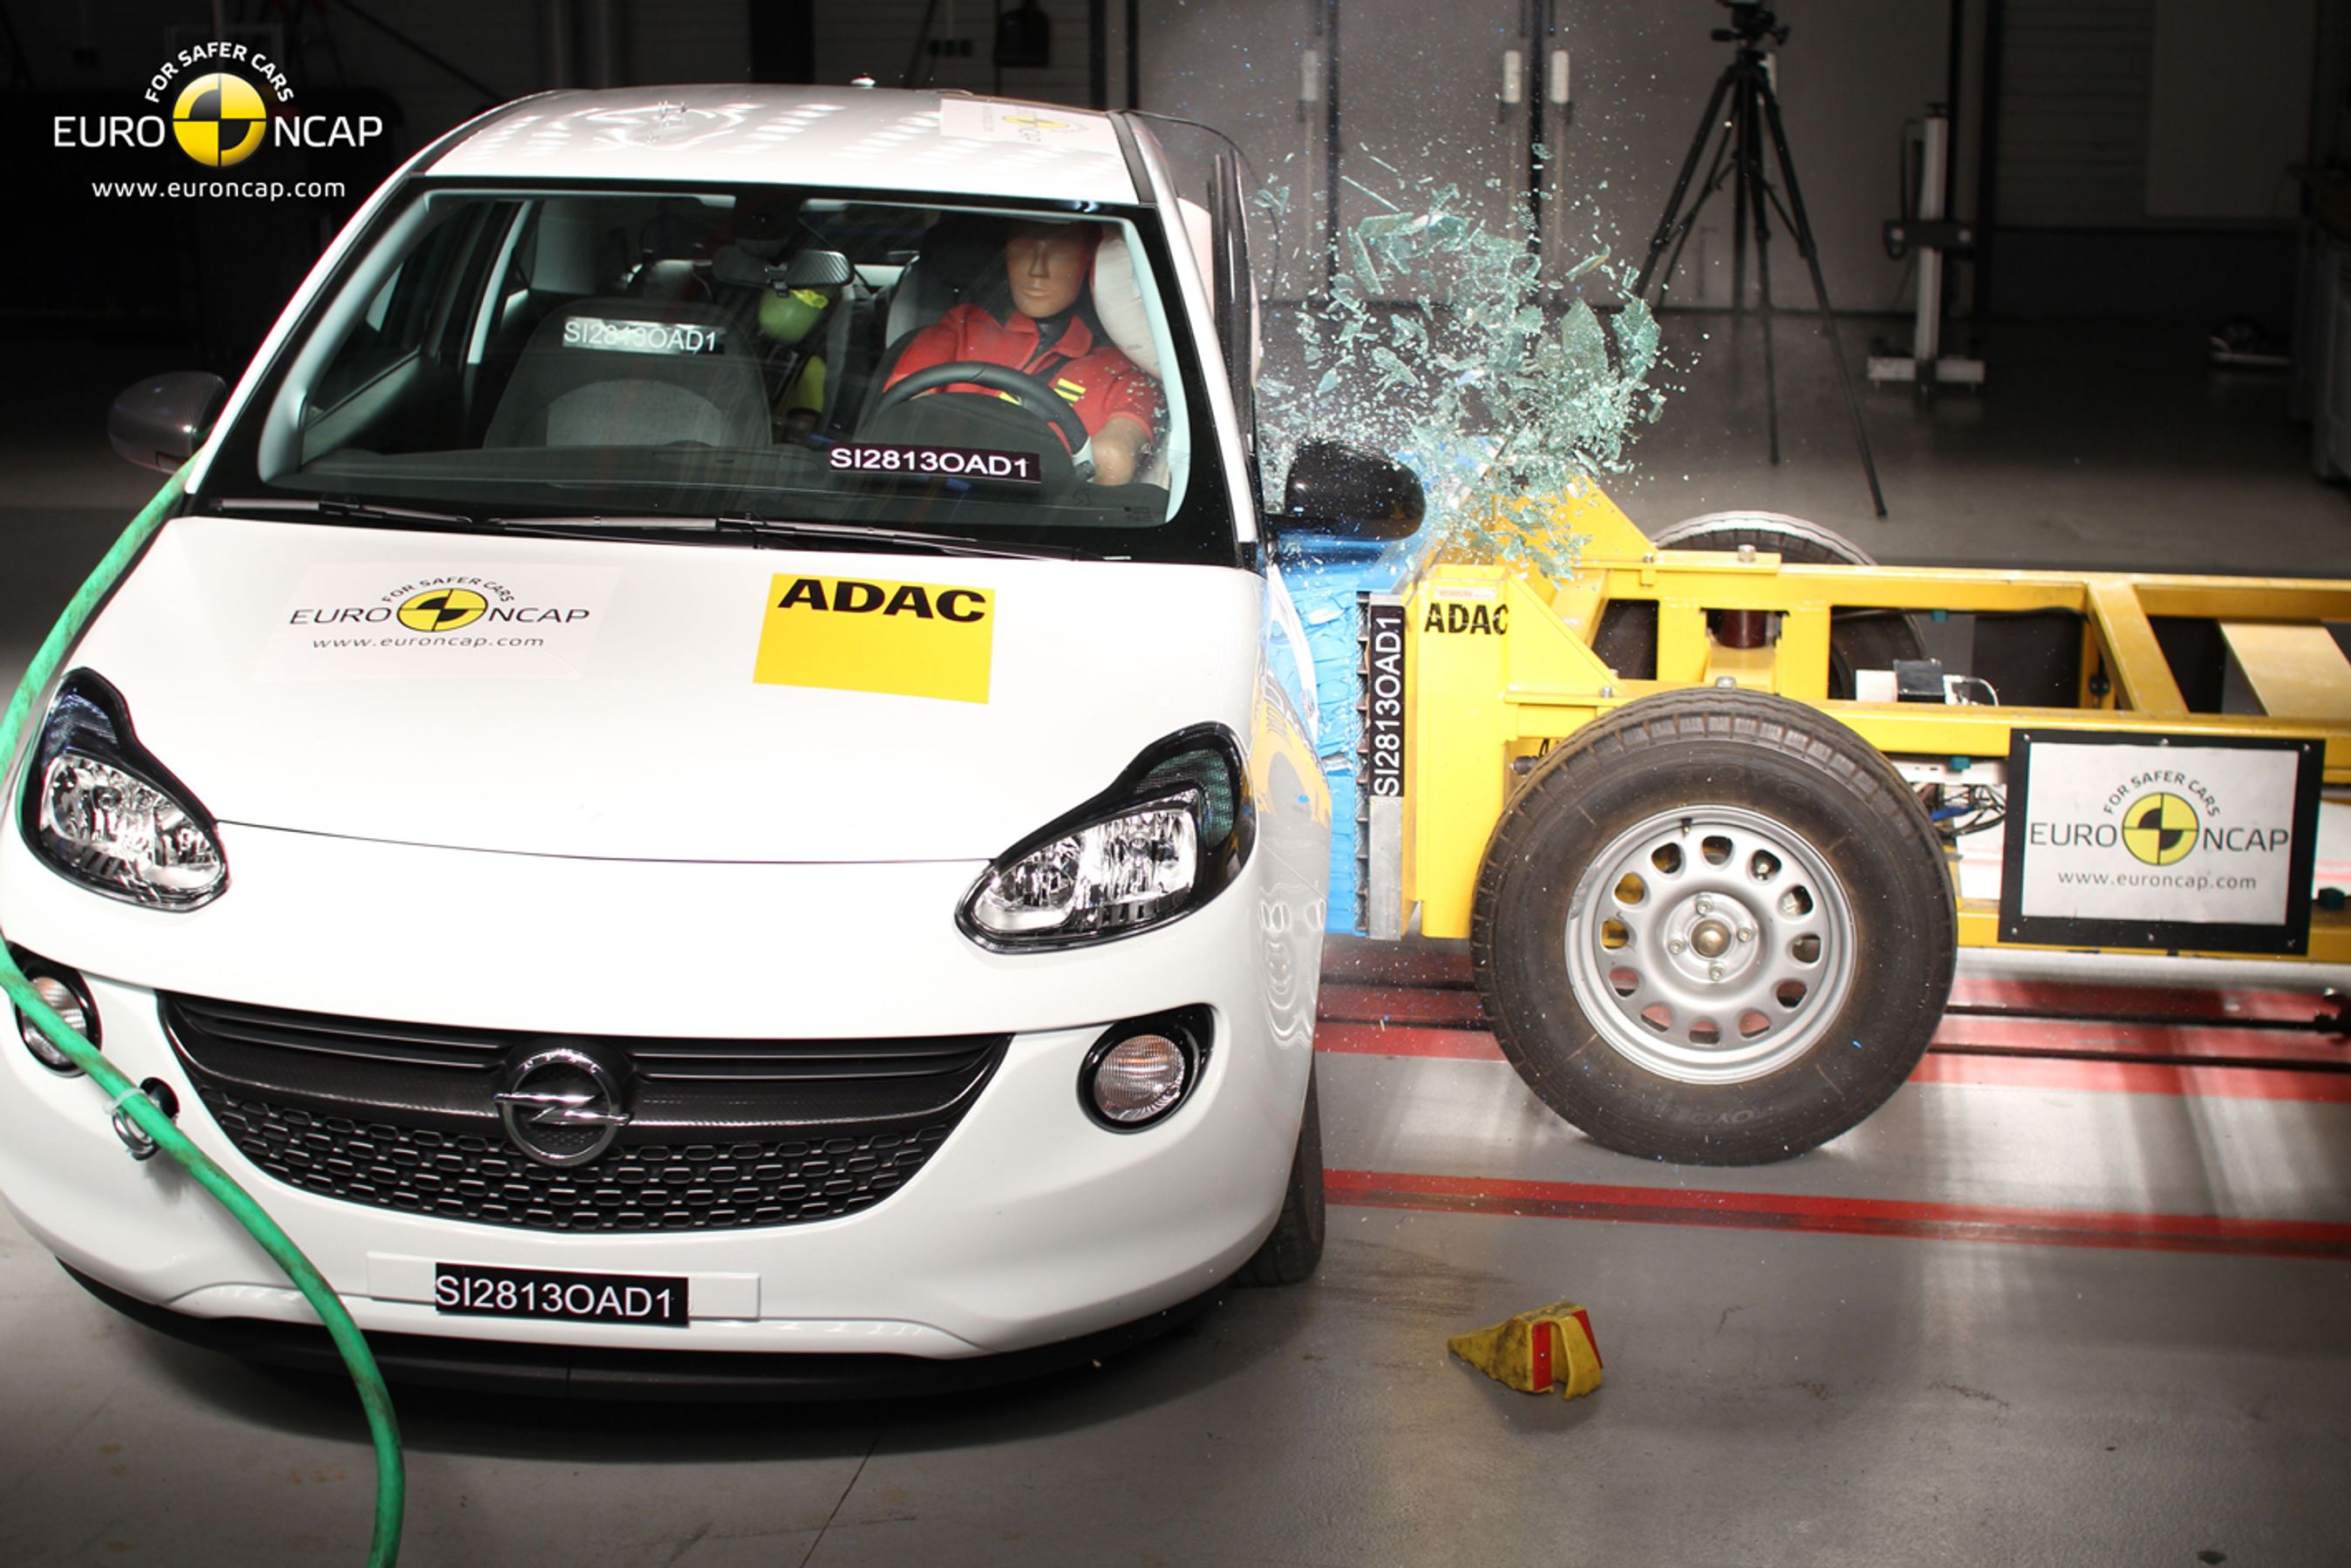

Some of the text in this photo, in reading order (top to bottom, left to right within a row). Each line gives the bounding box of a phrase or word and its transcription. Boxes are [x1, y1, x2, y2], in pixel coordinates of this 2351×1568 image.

[381, 576, 515, 603] FOR SAFER CARS
[777, 578, 986, 624] ADAC
[289, 607, 590, 624] EURO NCAP
[1424, 603, 1509, 636] ADAC
[312, 636, 544, 650] www.euroncap.com
[2103, 770, 2221, 817] FOR SAFER CARS
[2030, 821, 2290, 853] EURO NCAP
[2058, 869, 2257, 891] www.euroncap.com
